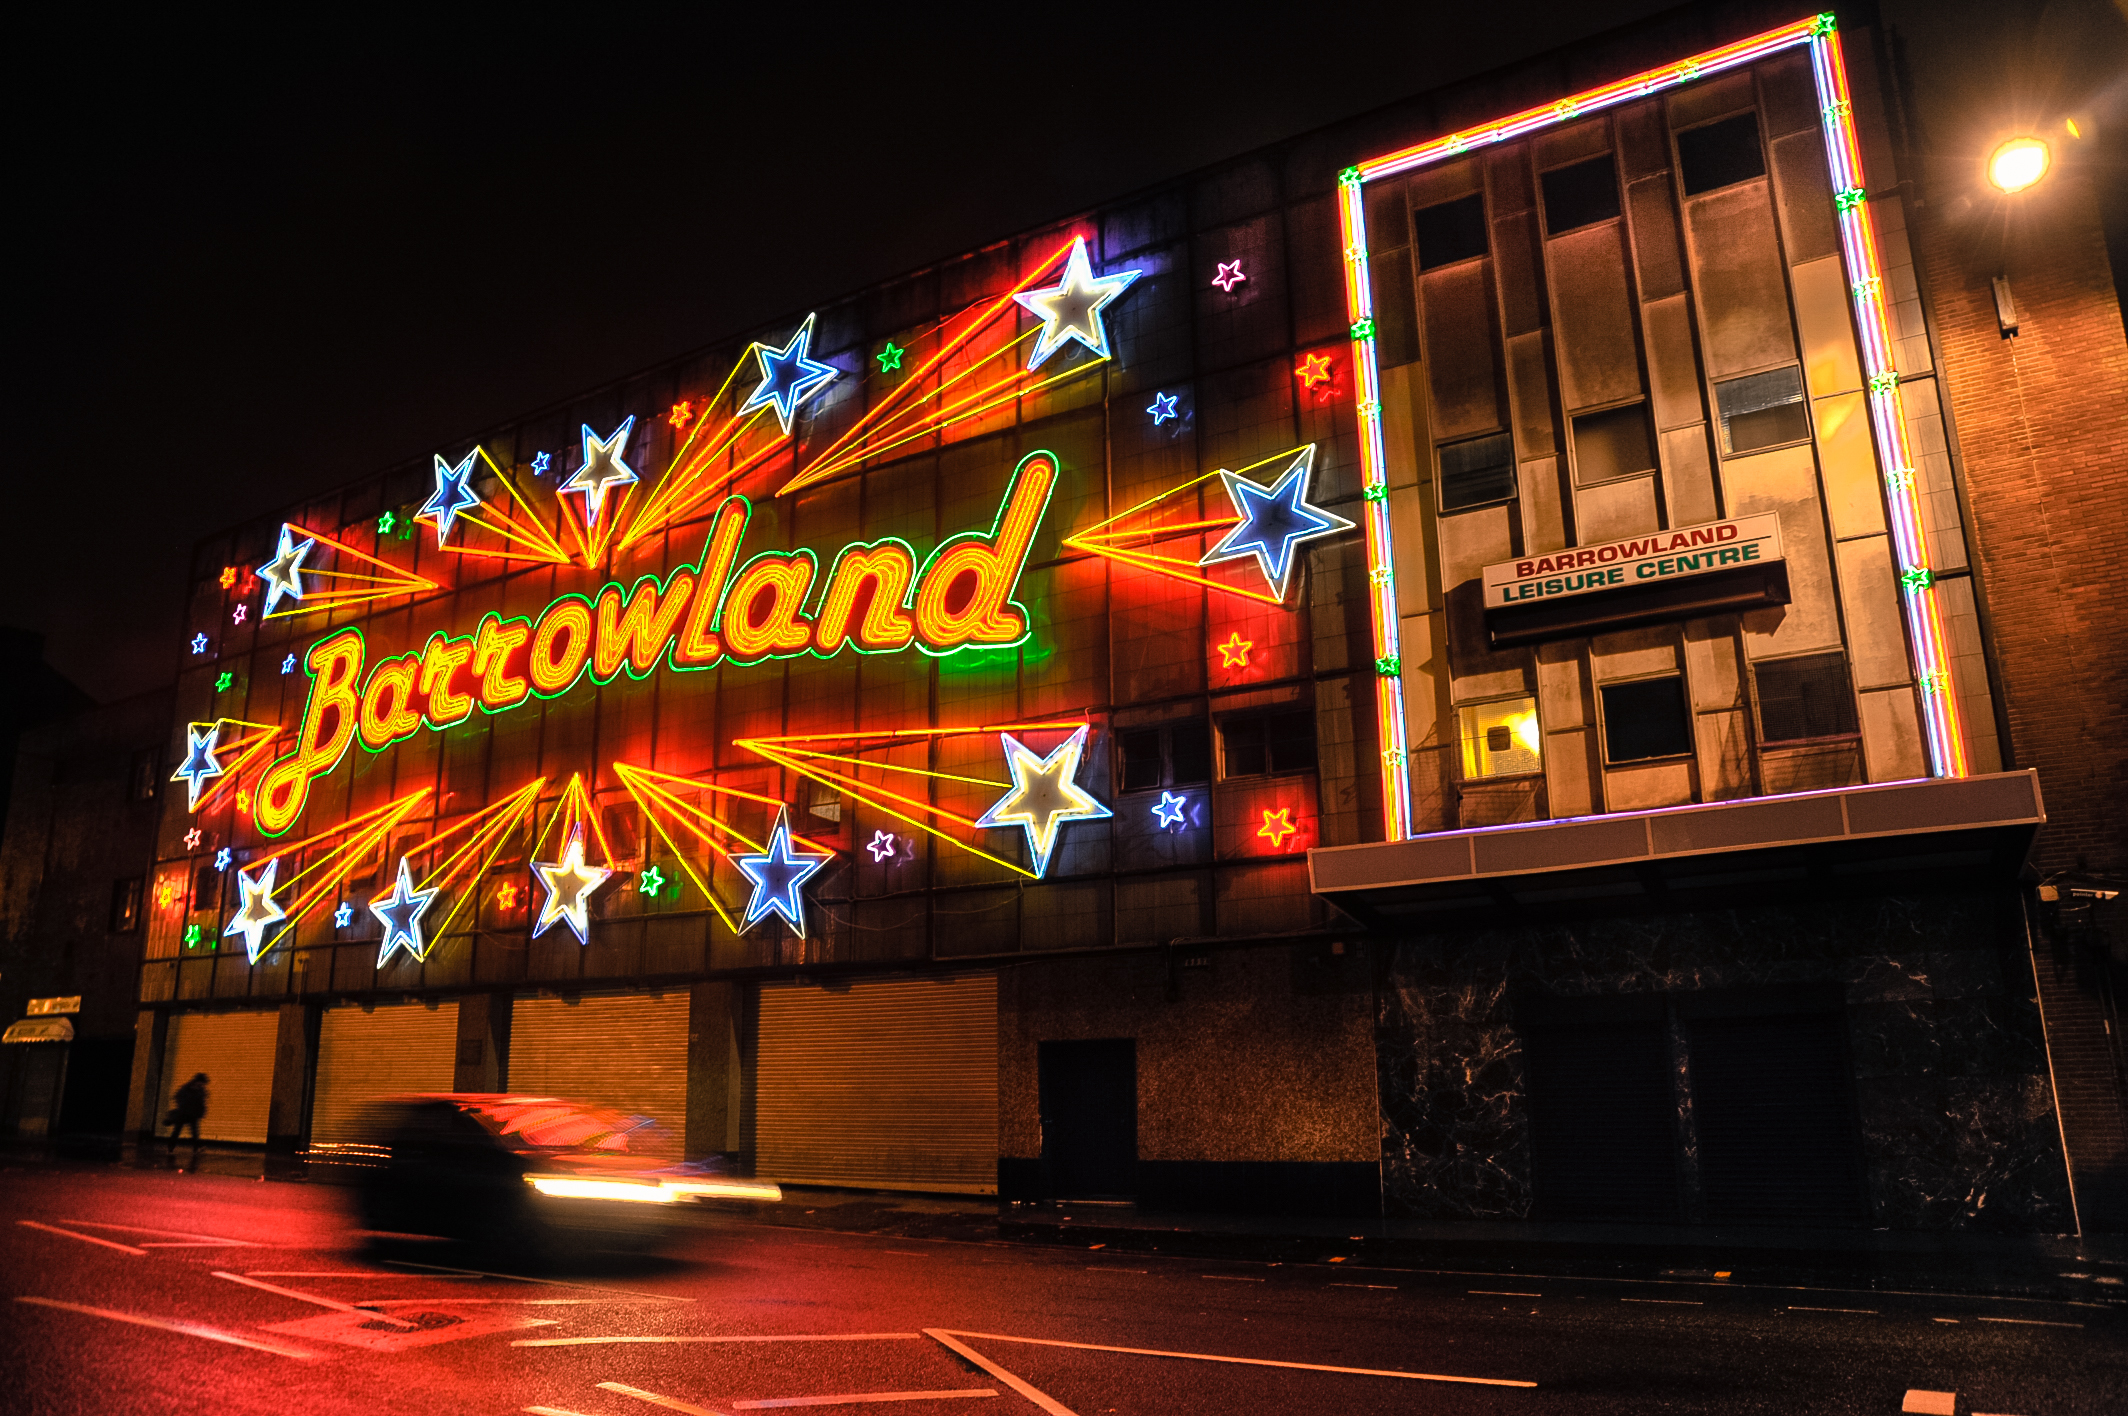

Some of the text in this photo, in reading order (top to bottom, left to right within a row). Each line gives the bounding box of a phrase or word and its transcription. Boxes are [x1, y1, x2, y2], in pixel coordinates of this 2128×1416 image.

[1503, 543, 1760, 602] LEISURE CENTRE
[1516, 524, 1738, 578] BARROWLAND
[255, 450, 1060, 837] Barrowland
